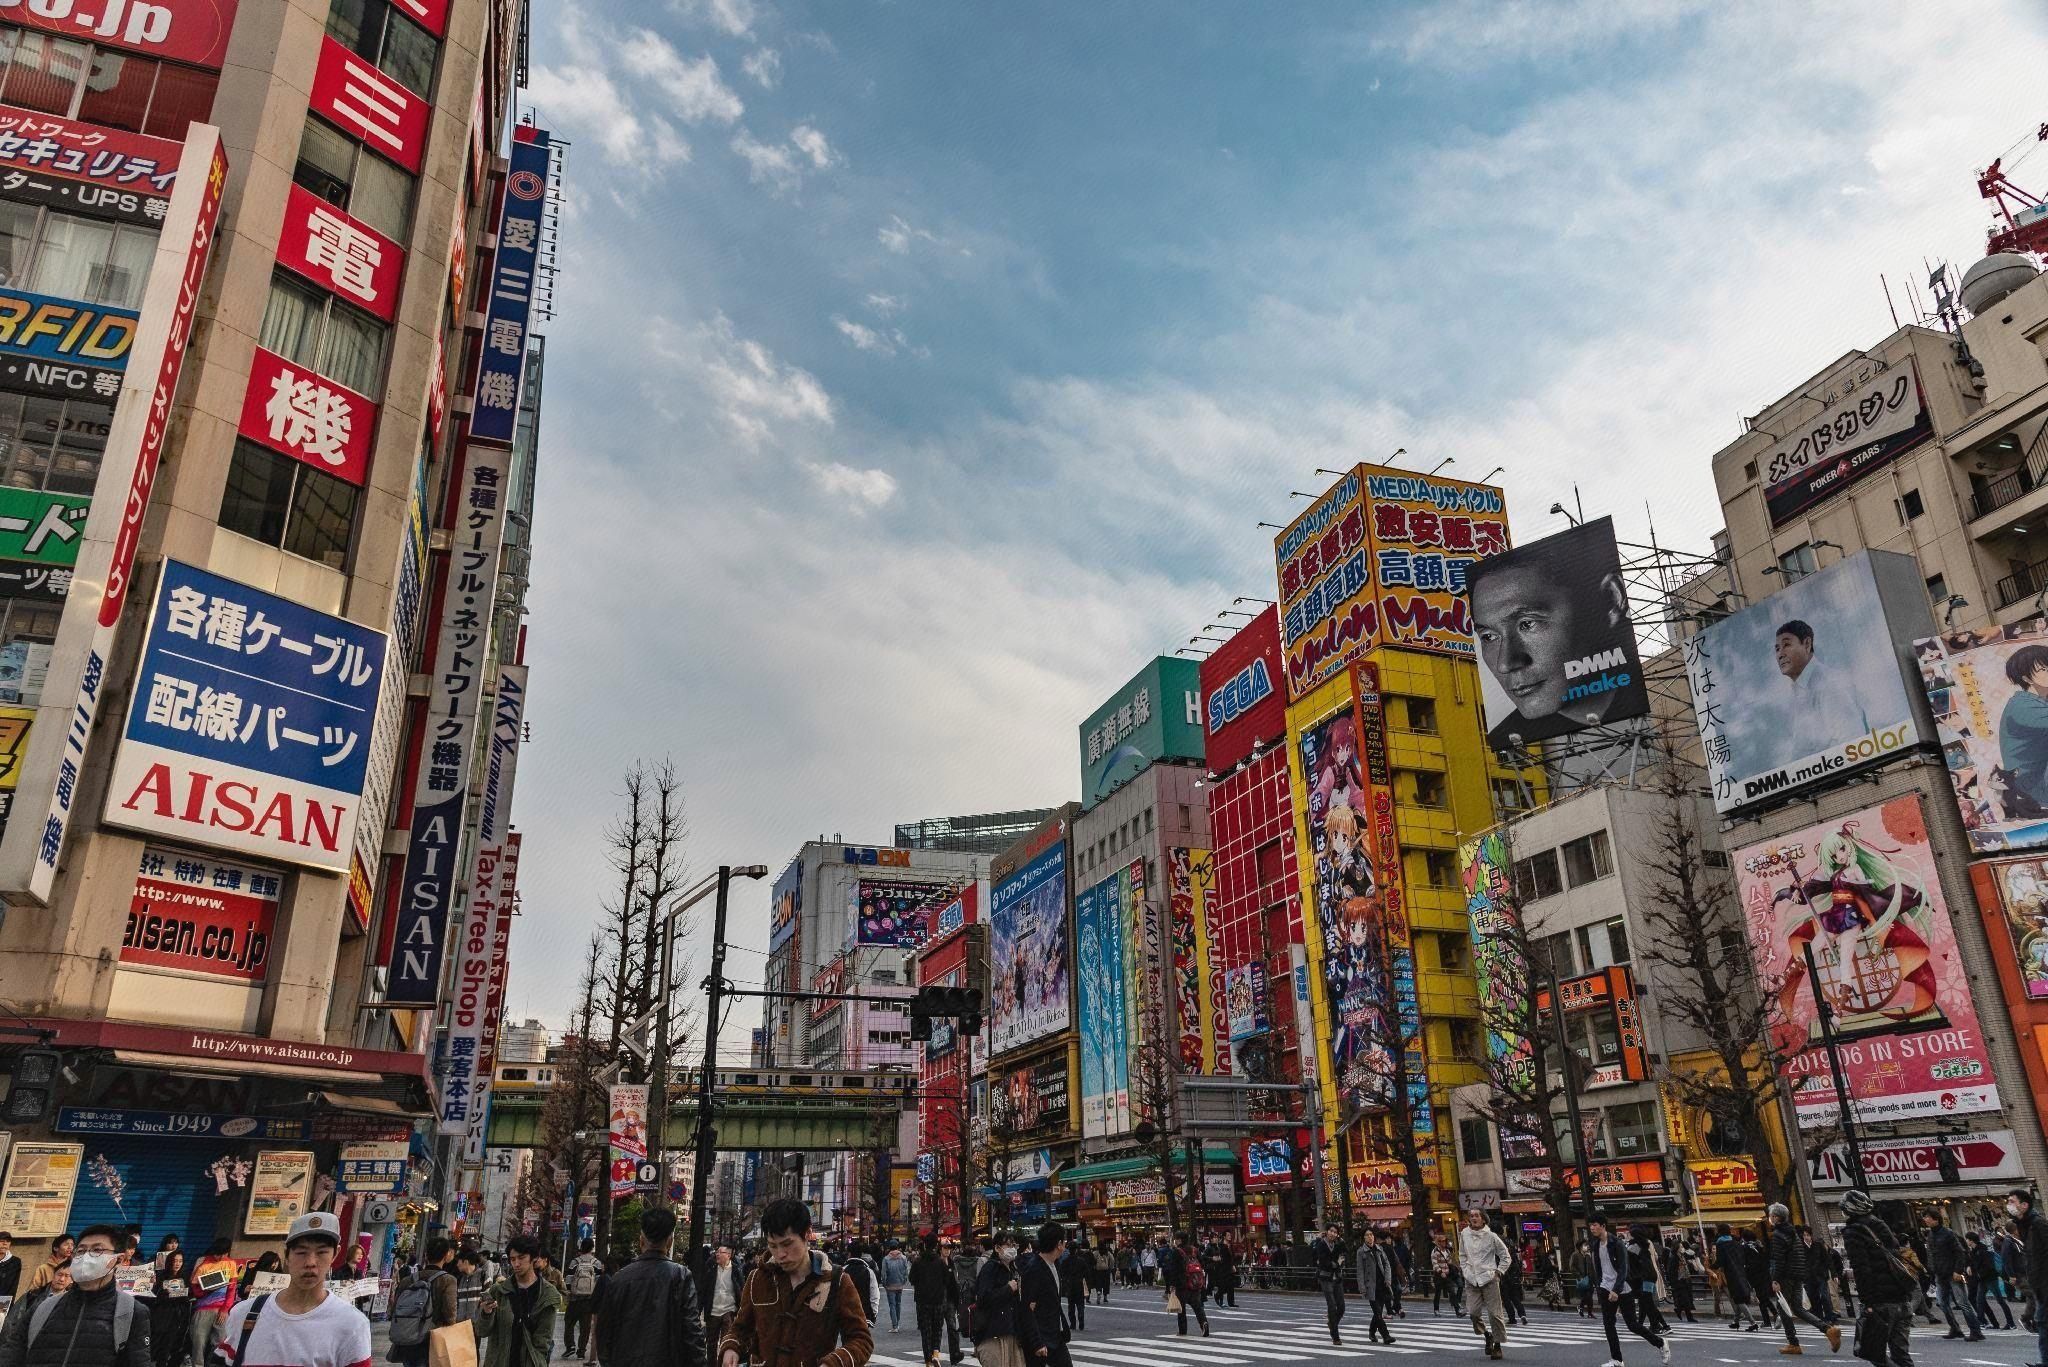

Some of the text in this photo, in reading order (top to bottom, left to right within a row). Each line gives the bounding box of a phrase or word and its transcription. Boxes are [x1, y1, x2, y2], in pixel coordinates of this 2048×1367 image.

[143, 197, 170, 220] 等
[0, 296, 139, 360] RFID
[480, 217, 535, 410] 愛三電機
[93, 372, 121, 396] 等
[1769, 375, 1909, 484] メイドカジノ
[1809, 444, 1881, 493] POKER STARS
[1367, 475, 1501, 513] MEDIAリサイクル
[0, 503, 88, 552] ード
[1374, 503, 1508, 556] 激安販売
[1377, 547, 1477, 595] 高額買
[1284, 547, 1369, 649] 高額買取
[166, 585, 373, 687] 各種ケーブル
[428, 466, 499, 791] 各種ケーブル・ネットワーク機器
[1288, 601, 1379, 697] Mulan
[1401, 633, 1444, 648] ムーラン
[1560, 672, 1631, 702] .make
[1563, 647, 1628, 680] DMM
[144, 672, 358, 768] 配線パーツ
[495, 673, 523, 756] AKKY
[1208, 657, 1274, 735] SEGA
[1363, 705, 1379, 713] DVD
[1368, 732, 1379, 740] CD
[1684, 635, 1743, 808] 次は太陽か。
[1845, 724, 1908, 763] solar
[40, 648, 104, 868] 愛三電機
[121, 762, 347, 853] AISAN
[480, 732, 504, 843] INTERNATIONAL
[213, 867, 243, 891] 在庫
[401, 815, 449, 981] AISAN
[454, 845, 502, 1028] Tax-free Shop
[1144, 903, 1159, 955] AKKY
[1750, 886, 1777, 968] ムラサメ
[487, 930, 508, 997] カラオケ
[1295, 964, 1309, 1002] SEGA
[1561, 980, 1593, 1000] 吉野家
[1617, 997, 1636, 1048] 吉野家
[1871, 1040, 1892, 1062] IN
[1898, 1029, 1975, 1059] STORE
[192, 1035, 354, 1065] http://www.aisan.co.jp
[442, 1036, 476, 1122] 愛客本店
[132, 1119, 165, 1133] Since
[166, 1114, 213, 1133] 1949
[467, 1080, 488, 1155] ダーツバー
[1877, 1103, 1900, 1114] goods
[1901, 1101, 1916, 1111] and
[1917, 1100, 1938, 1109] more
[346, 1149, 404, 1160] aisan.co.jp
[1861, 1149, 1930, 1172] COMIC
[1915, 1135, 1939, 1147] Magazi
[343, 1161, 402, 1174] 愛三電機
[1867, 1171, 1921, 1184] kihabara
[1464, 1193, 1496, 1209] ラーメン
